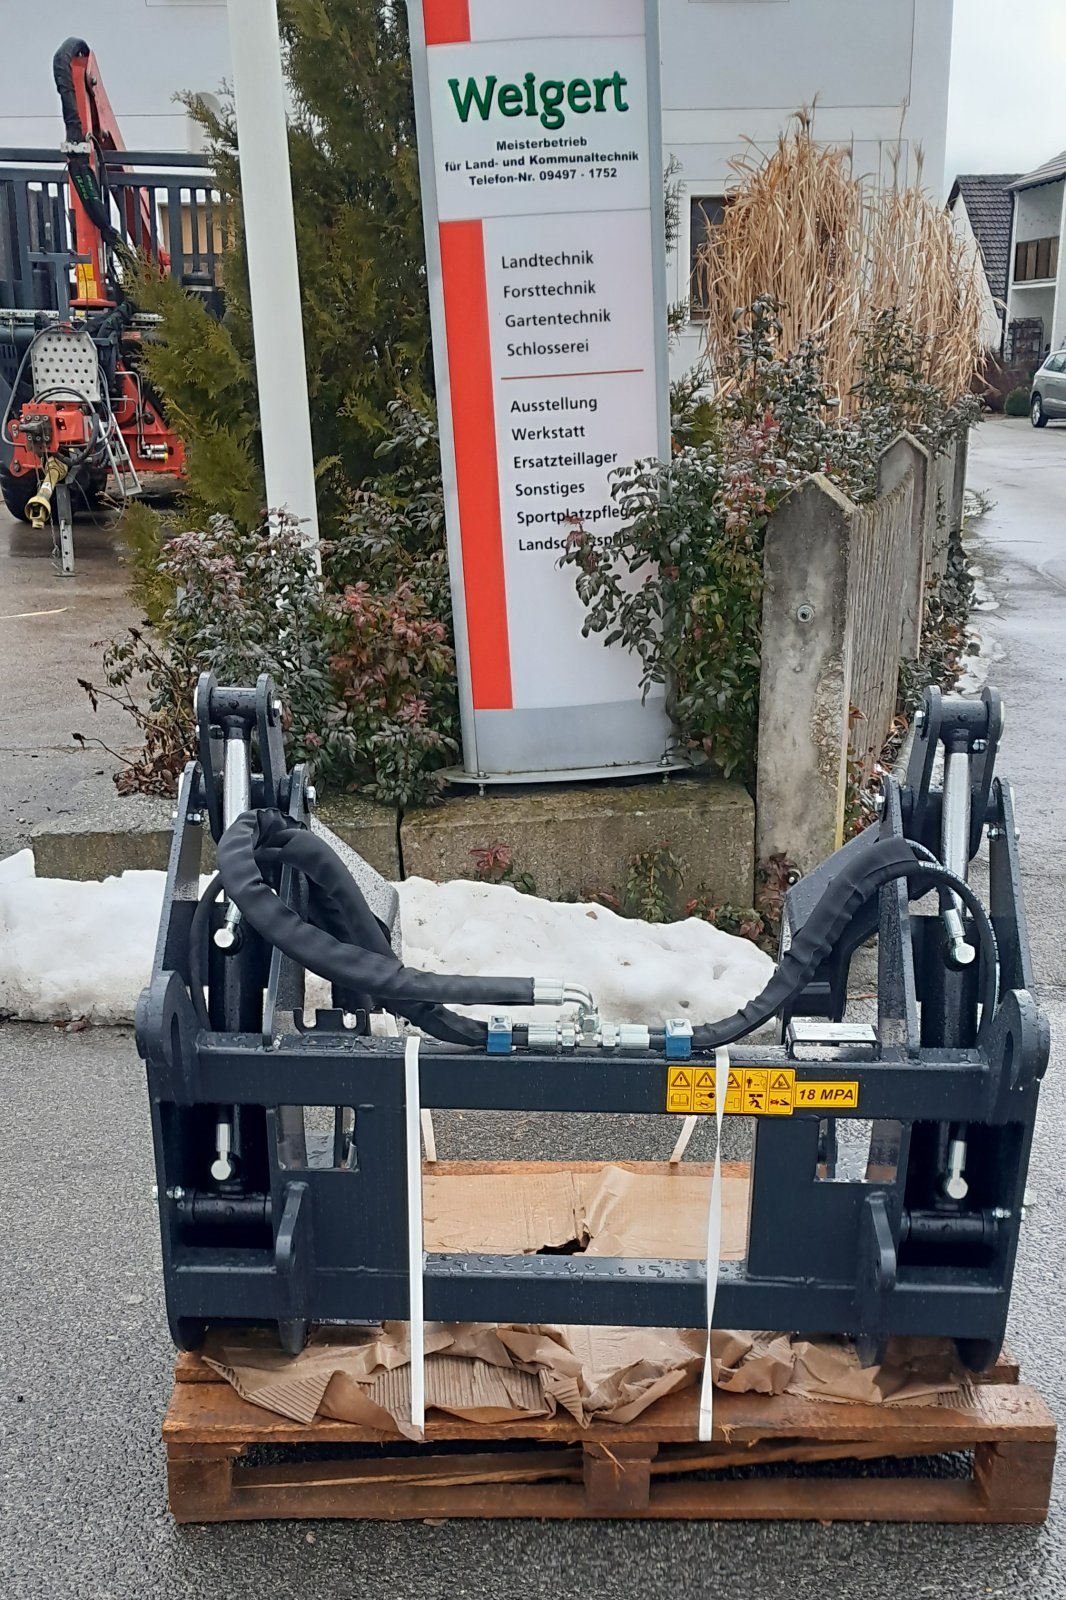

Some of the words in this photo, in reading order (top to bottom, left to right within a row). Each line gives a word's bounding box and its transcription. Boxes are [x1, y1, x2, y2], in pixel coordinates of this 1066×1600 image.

[448, 71, 629, 130] Weigert
[497, 137, 587, 151] Meisterbetrieb
[445, 162, 461, 172] für
[465, 158, 498, 170] Land-
[503, 156, 525, 167] und
[530, 151, 639, 166] Kommunaltechnik
[469, 171, 535, 186] Telefon-Nr.
[539, 169, 577, 181] 09497
[588, 168, 617, 179] 1752
[501, 250, 594, 269] Landtechnik
[503, 280, 596, 299] Forsttechnik
[505, 308, 611, 328] Gartentechnik
[507, 339, 589, 357] Schlosserei
[510, 396, 597, 412] Ausstellung
[511, 425, 586, 441] Werkstatt
[514, 452, 618, 469] Ersatzteillager
[515, 481, 585, 497] Sonstiges
[517, 505, 630, 526] Sportplatzpfleg
[799, 1089, 816, 1101] 18
[820, 1089, 854, 1101] MPA
